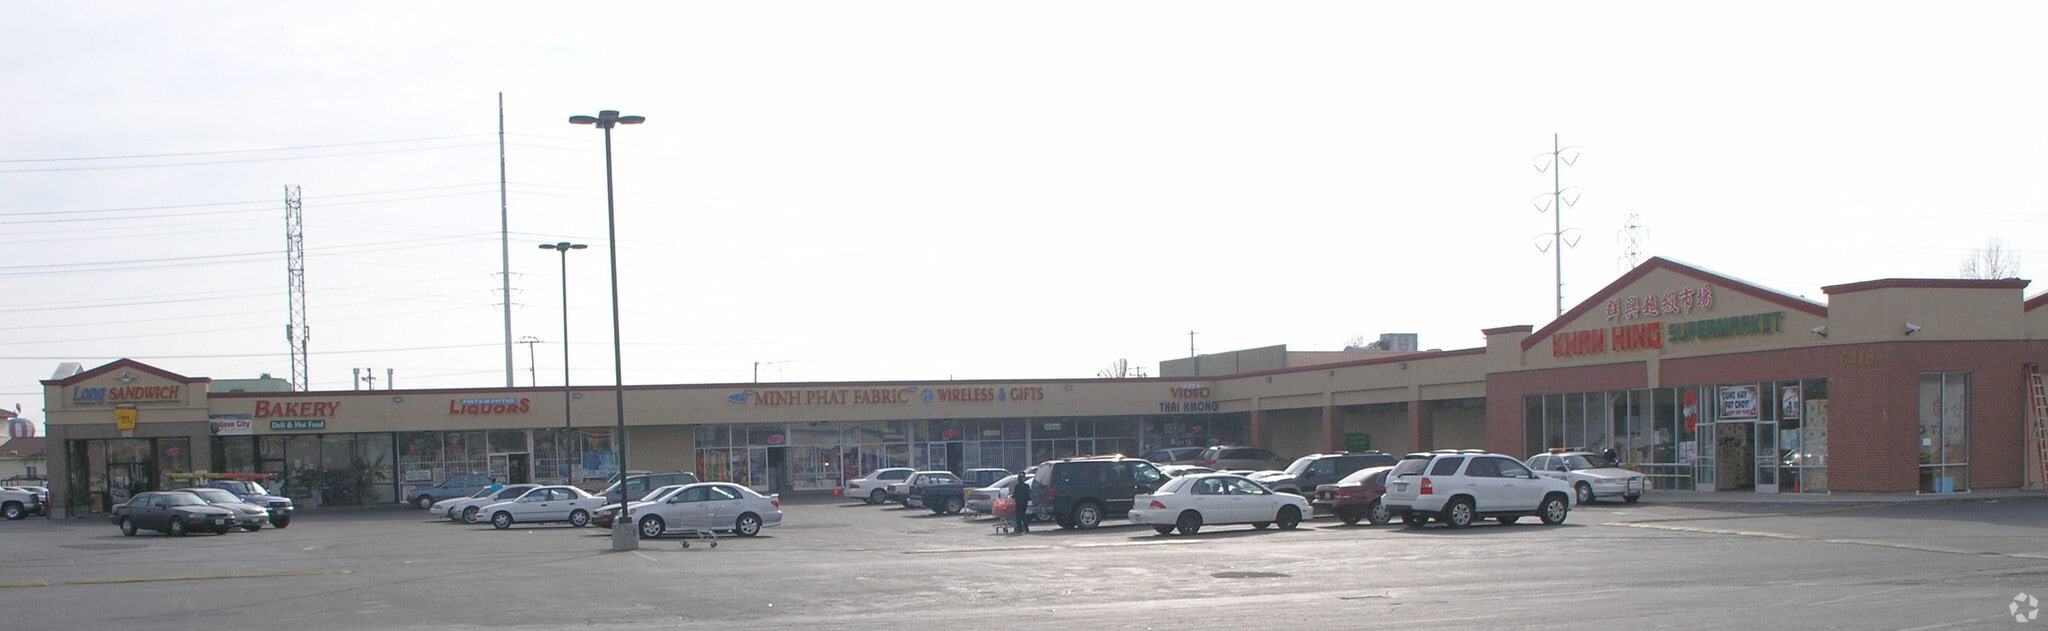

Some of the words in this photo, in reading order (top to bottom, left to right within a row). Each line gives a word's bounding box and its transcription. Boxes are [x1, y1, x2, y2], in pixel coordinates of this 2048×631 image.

[1553, 328, 1606, 358] KHAN
[1611, 322, 1662, 351] HING
[1669, 310, 1785, 343] SUPERMARKET
[73, 385, 107, 405] Long
[108, 386, 180, 400] SANDWICH
[755, 391, 801, 406] MINH
[807, 390, 849, 404] PHAT
[854, 389, 909, 403] FABRIC
[937, 388, 995, 402] WIRELESS
[998, 387, 1008, 402] &
[1010, 387, 1045, 401] GIFTS
[1171, 387, 1210, 398] VIDEO
[254, 400, 341, 418] BAKERY
[1160, 402, 1180, 412] THAI
[1184, 401, 1219, 412] HMONG
[294, 421, 308, 429] Hot
